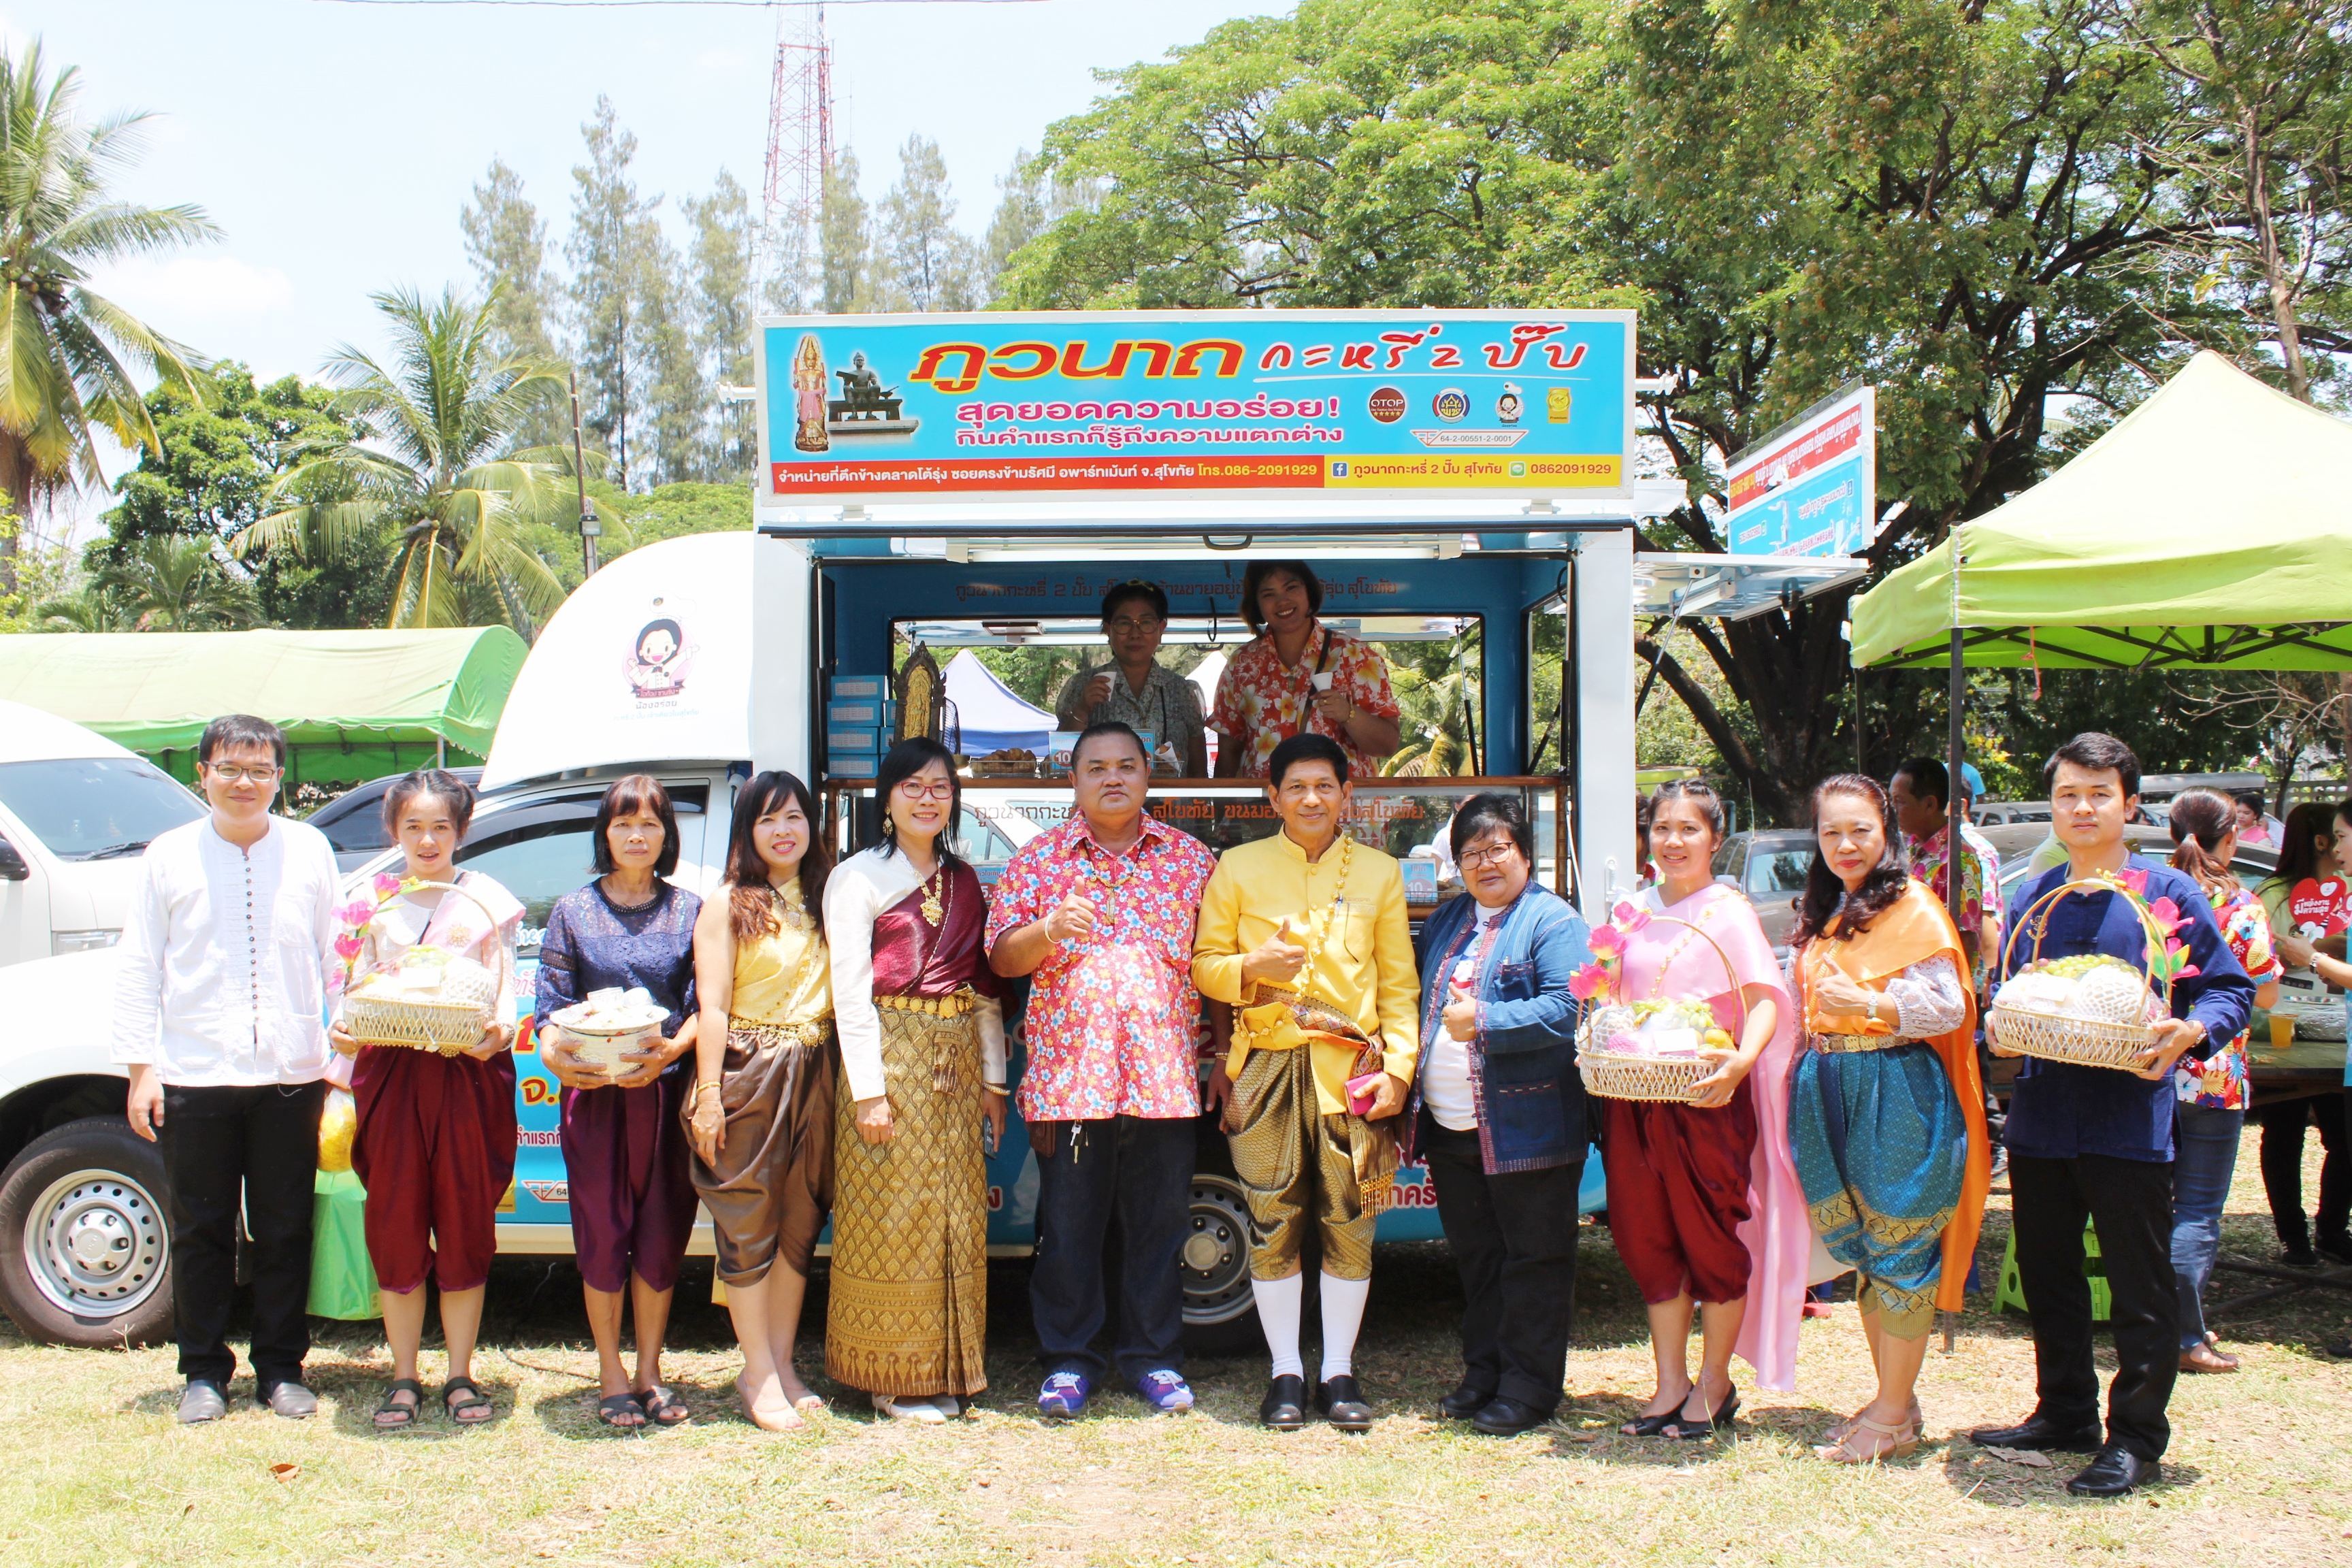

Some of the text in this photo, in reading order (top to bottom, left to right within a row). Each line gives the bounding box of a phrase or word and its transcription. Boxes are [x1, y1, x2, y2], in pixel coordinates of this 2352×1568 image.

[909, 340, 1244, 393] ภูวนาถ
[1260, 326, 1441, 370] กะหรี่
[1484, 325, 1585, 368] ปั๊บ
[956, 394, 1339, 428] สุดยอดความอร่อย!
[1371, 399, 1404, 407] OTOP
[957, 425, 1342, 449] กินคำแรกก็รู้ถึงความแตกต่าง
[1440, 435, 1512, 443] 64-2-00551-2-0001
[778, 466, 947, 484] จำหน่ายที่ตึกข้างตลาดโต้รุ่ง
[951, 464, 1056, 480] ซอยตรงข้ามรัศมี
[1141, 463, 1194, 481] จ.สุโขทัย
[1353, 459, 1503, 478] ภูวนาถกะหรี่ 2 ปั๊บ สุโขทัย
[1531, 464, 1612, 474] 0862091929
[1054, 584, 1066, 597] 2
[636, 700, 678, 710] น้องอร่อย
